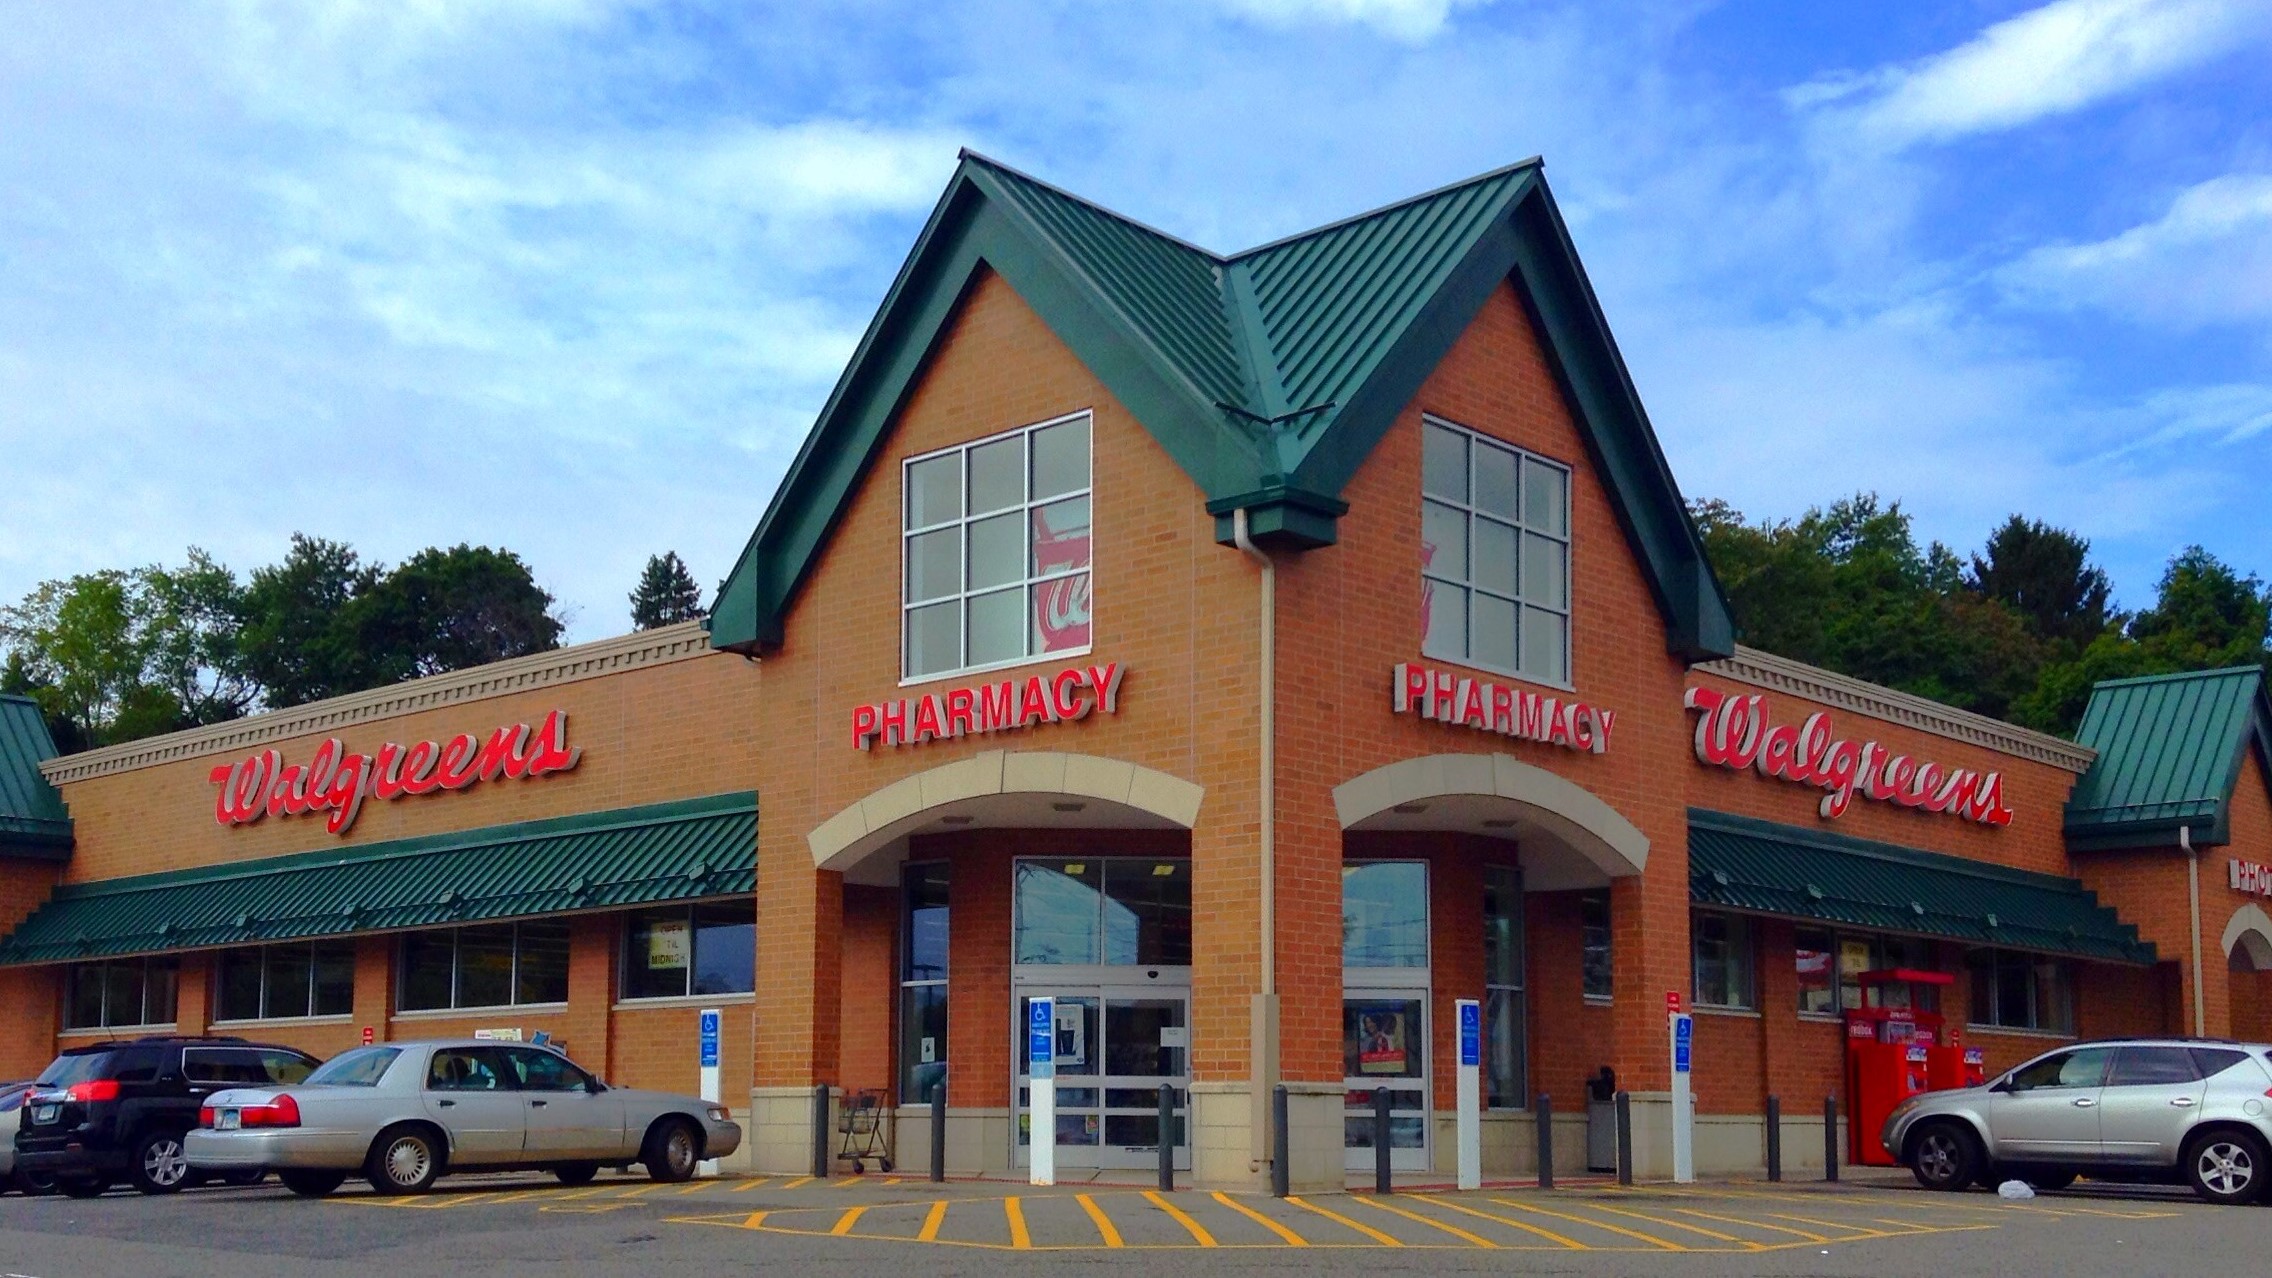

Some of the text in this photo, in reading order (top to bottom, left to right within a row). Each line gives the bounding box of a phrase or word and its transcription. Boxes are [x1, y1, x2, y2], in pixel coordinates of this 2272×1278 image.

[852, 661, 1124, 751] PHARMACY
[1394, 662, 1616, 753] PHARMACY
[1684, 687, 2013, 826] Walgreens
[209, 709, 581, 834] Walgreens
